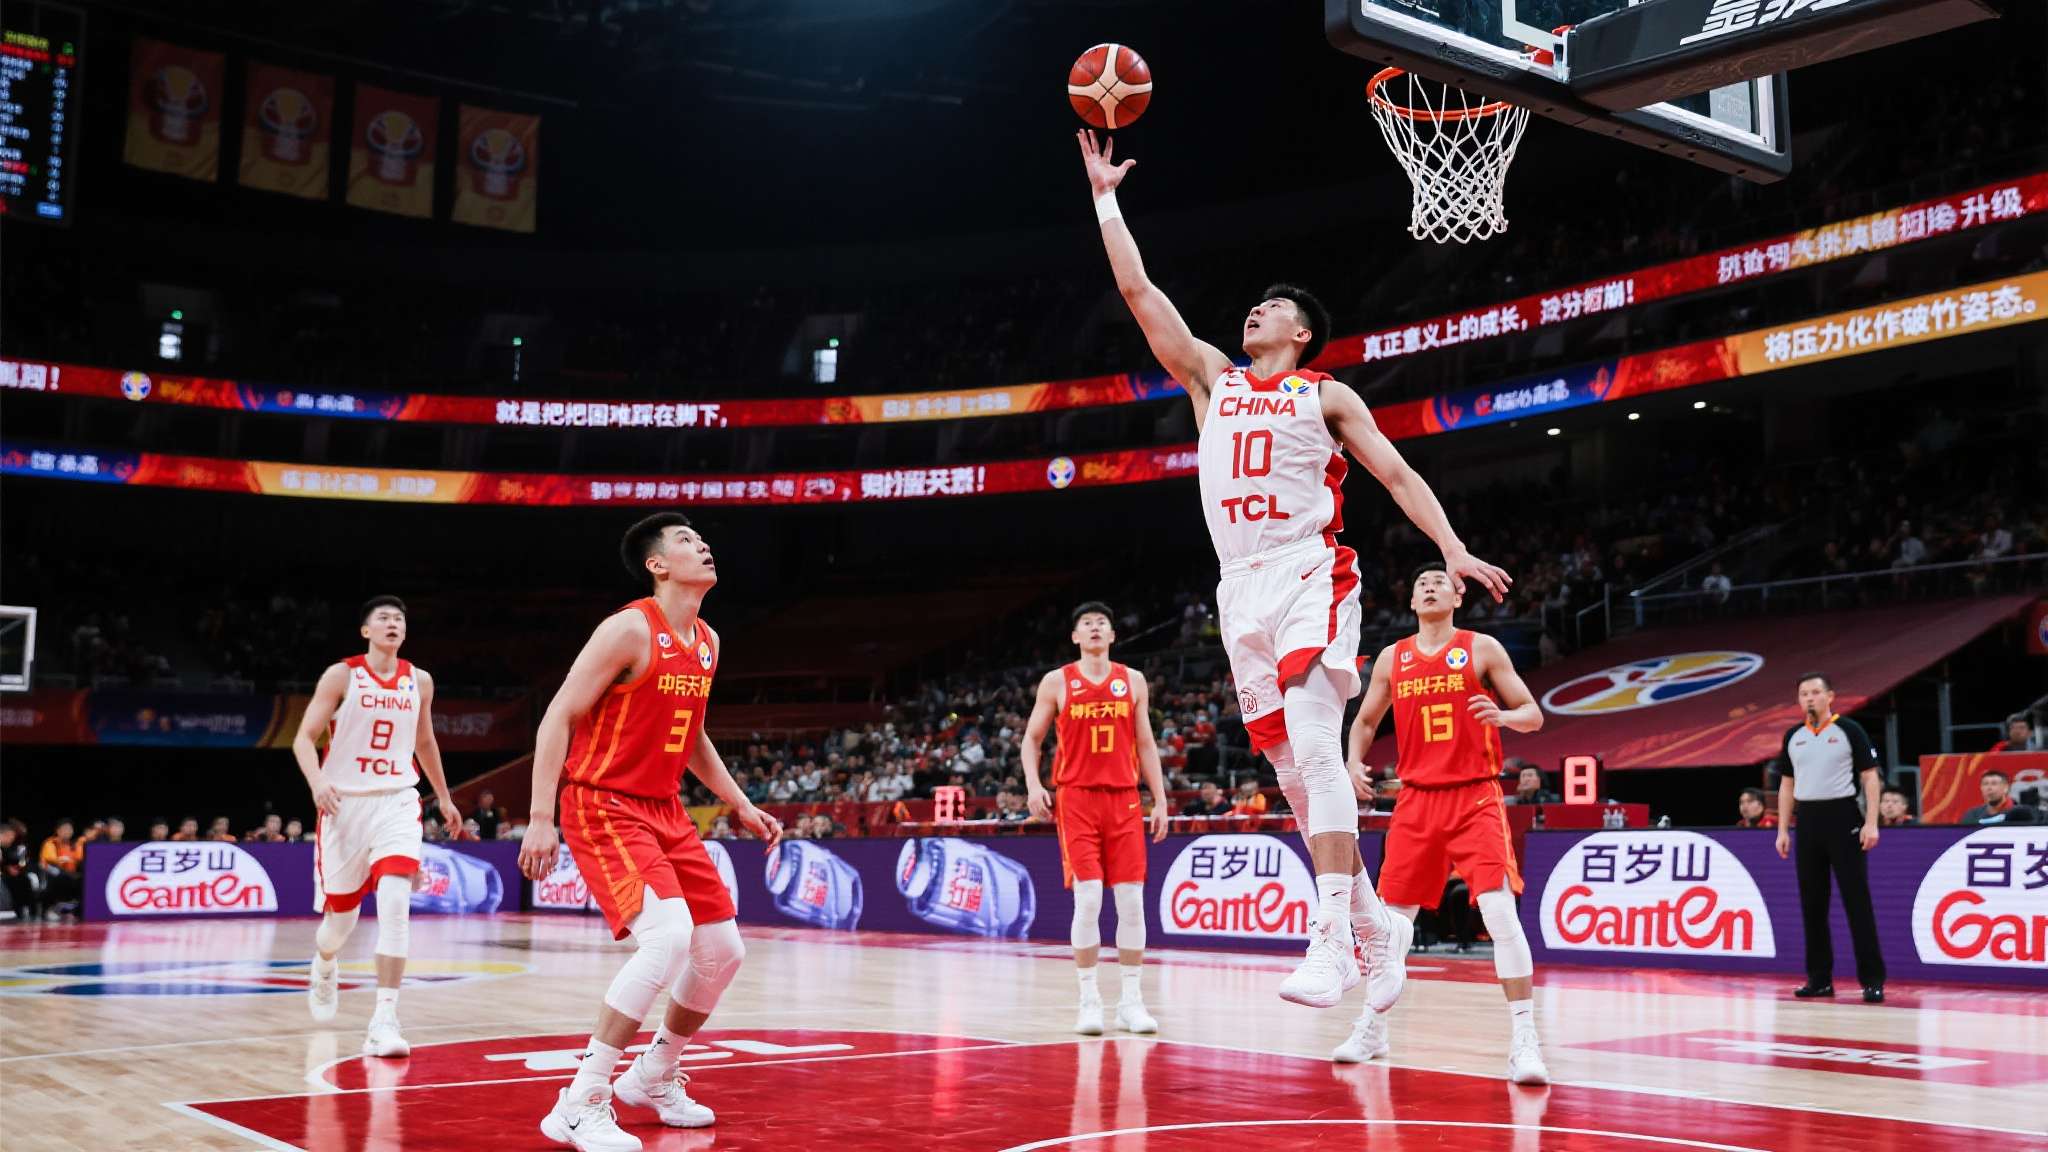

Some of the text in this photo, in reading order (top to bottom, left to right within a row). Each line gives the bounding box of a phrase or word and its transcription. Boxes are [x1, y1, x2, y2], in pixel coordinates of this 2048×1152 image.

[1764, 285, 2036, 362] 将压力化作破竹姿态。
[1219, 396, 1296, 416] CHINA
[1232, 429, 1273, 479] 10
[1221, 495, 1290, 523] TCL
[361, 694, 412, 711] CHINA
[370, 719, 394, 750] 8
[664, 709, 693, 752] 3
[356, 757, 402, 775] TCL
[1564, 756, 1597, 805] 8
[140, 849, 234, 873] 百岁山
[1191, 846, 1281, 879] 百岁山
[1582, 844, 1711, 884] 百岁山
